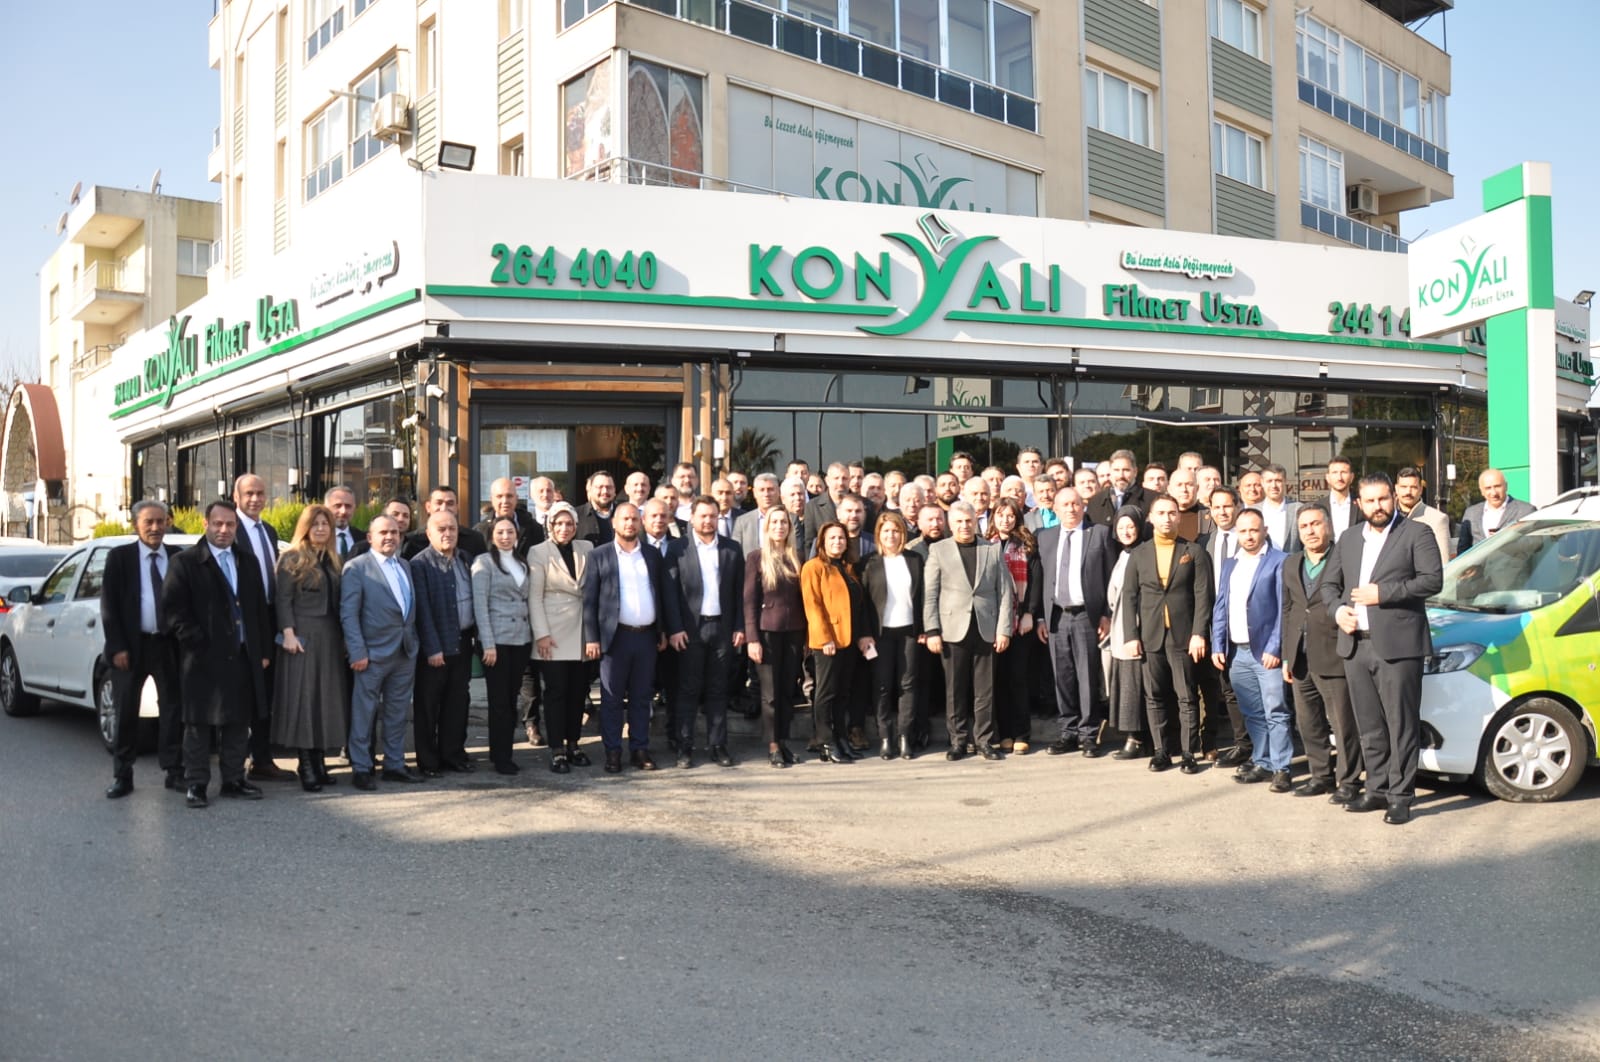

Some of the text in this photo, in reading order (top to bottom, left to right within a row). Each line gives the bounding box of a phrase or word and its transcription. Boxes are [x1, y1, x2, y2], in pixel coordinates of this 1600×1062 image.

[776, 118, 796, 134] Lezzet
[491, 243, 658, 289] 264 4040
[1125, 252, 1137, 265] Bu
[1138, 254, 1162, 267] Lezzet
[1163, 256, 1180, 270] Asla
[1418, 243, 1508, 317] KONYALI
[749, 232, 1061, 336] KONYALI
[1328, 301, 1375, 335] 244
